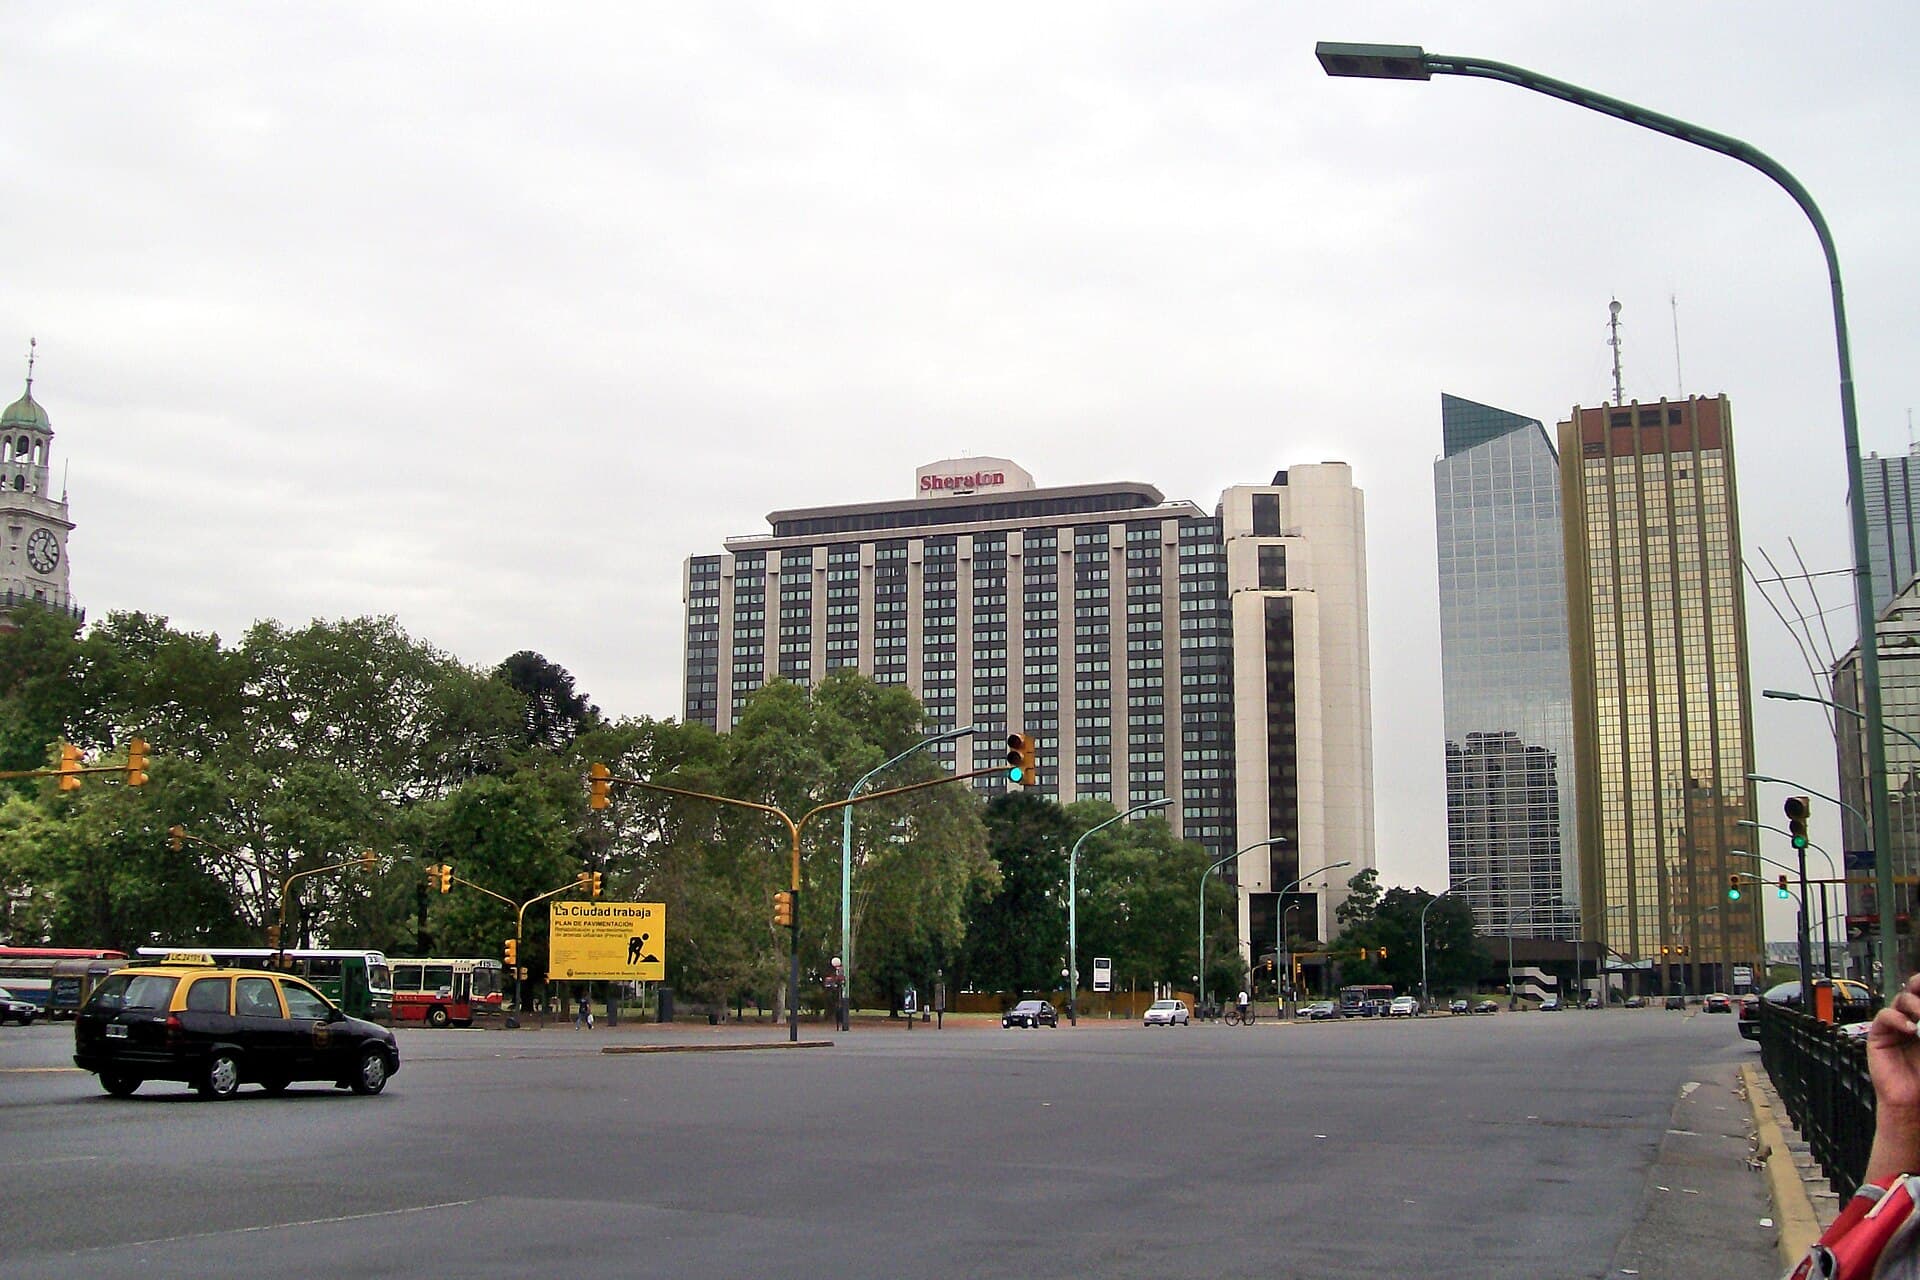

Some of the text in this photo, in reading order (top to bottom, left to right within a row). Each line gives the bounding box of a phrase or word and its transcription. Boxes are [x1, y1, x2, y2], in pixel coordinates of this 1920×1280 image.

[920, 472, 1004, 490] Sheraton
[555, 906, 651, 919] La Ciudad trabaja
